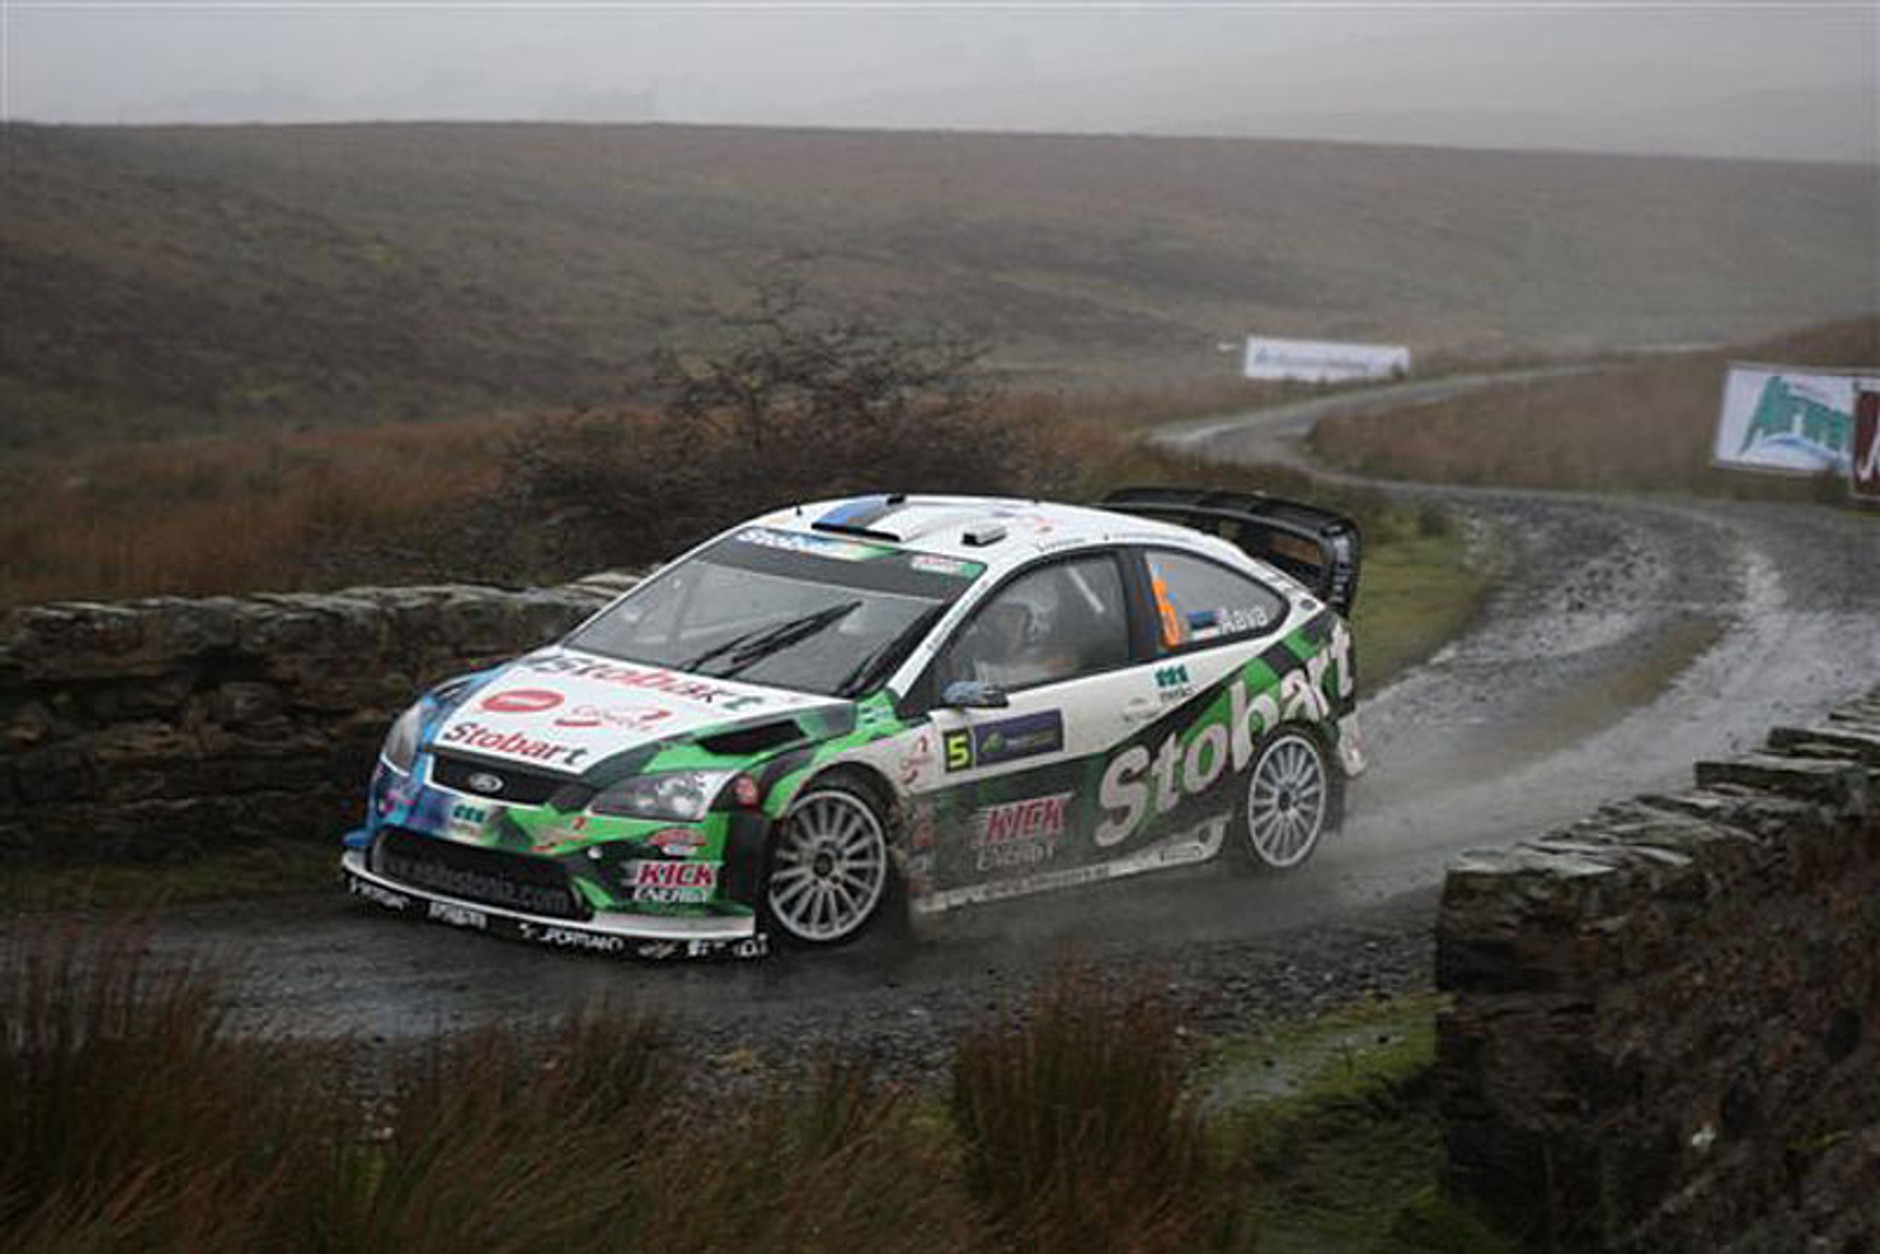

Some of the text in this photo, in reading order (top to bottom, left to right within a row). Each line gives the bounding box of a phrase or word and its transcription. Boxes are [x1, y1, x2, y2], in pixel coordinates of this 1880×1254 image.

[443, 721, 589, 767] Stobart
[947, 734, 970, 770] 5
[1093, 617, 1353, 848] Stobart
[984, 797, 1064, 845] KICK
[639, 862, 715, 886] KICK
